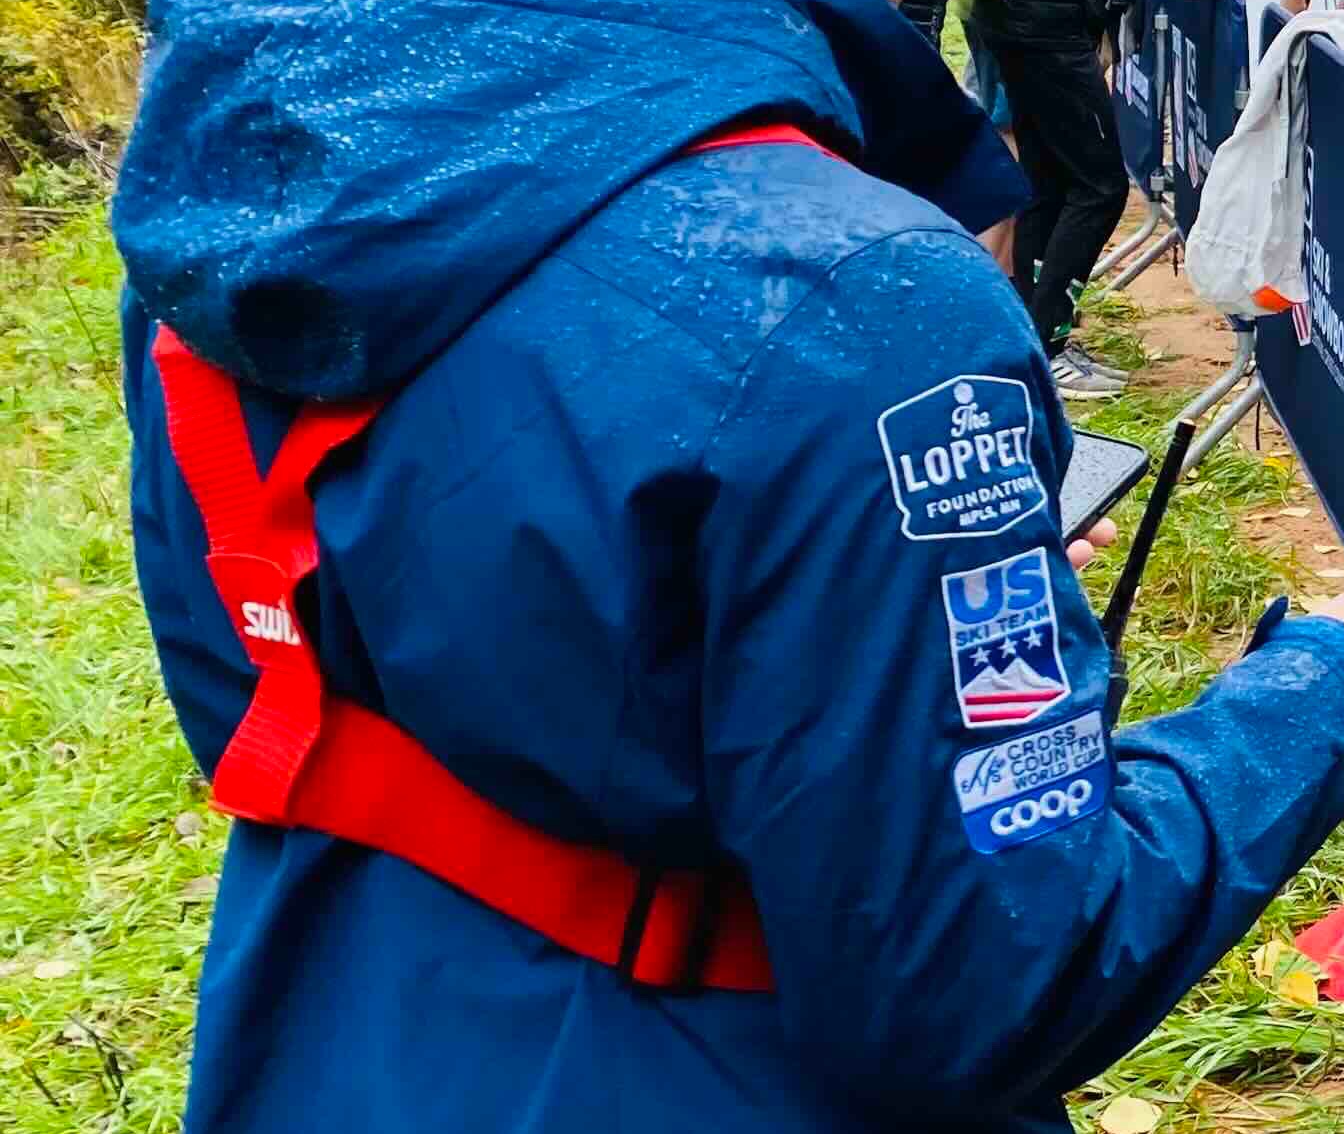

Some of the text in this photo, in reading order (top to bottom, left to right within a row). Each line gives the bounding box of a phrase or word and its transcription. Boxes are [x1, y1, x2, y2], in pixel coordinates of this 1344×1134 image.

[951, 402, 991, 437] The
[900, 426, 1026, 493] LOPPET
[926, 475, 1036, 519] FOUNDATION
[947, 555, 1047, 625] US
[242, 594, 301, 645] swi
[956, 604, 1052, 647] SKI TEAM
[1007, 725, 1076, 761] CROSS
[1010, 731, 1100, 776] COUNTRY
[1014, 762, 1069, 791] WORLD
[1074, 749, 1101, 768] CUP
